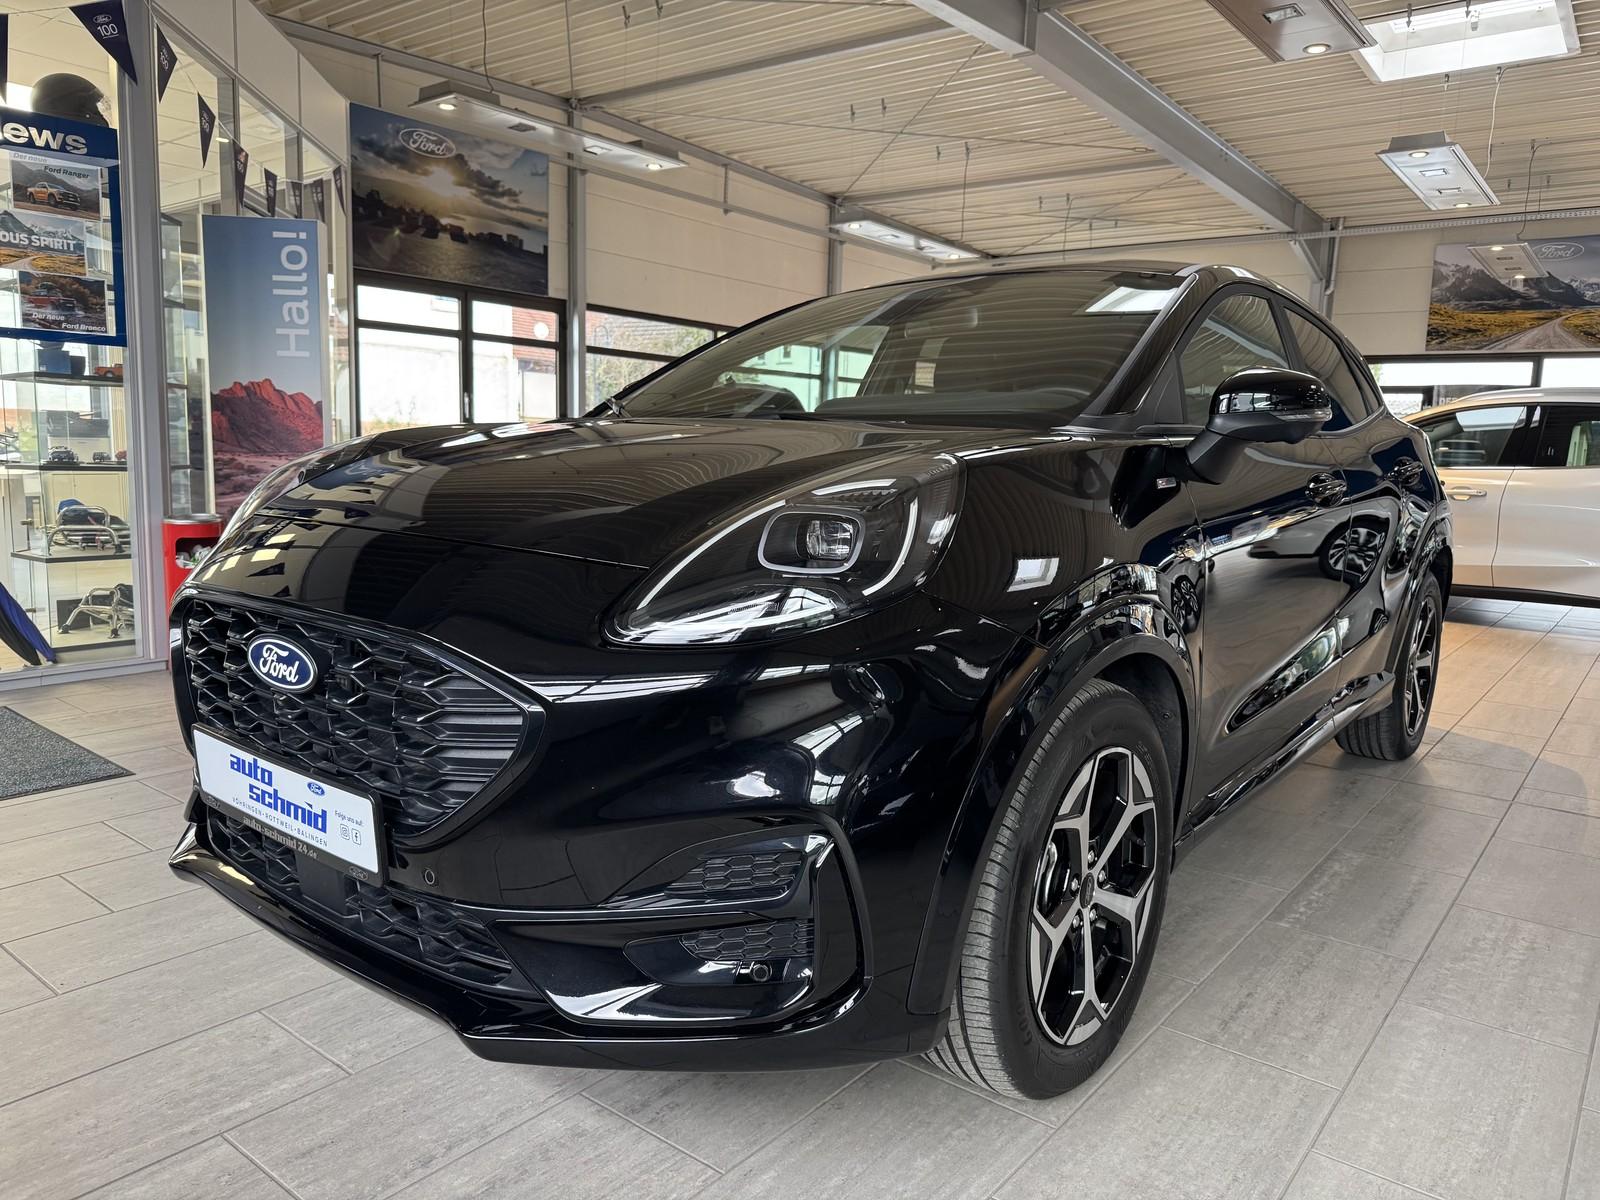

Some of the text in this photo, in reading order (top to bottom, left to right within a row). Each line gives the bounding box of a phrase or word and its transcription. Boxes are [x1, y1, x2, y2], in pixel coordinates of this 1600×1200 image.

[97, 23, 118, 37] 100
[0, 122, 88, 154] ews
[408, 131, 449, 155] Ford
[44, 165, 90, 179] Ford Ranger
[31, 236, 77, 251] SPIRIT
[1540, 245, 1575, 258] Ford
[272, 231, 310, 358] Hallo!
[61, 322, 106, 332] Ford Bronco
[260, 644, 299, 683] Ford
[229, 753, 273, 788] auto
[248, 783, 328, 834] schmid
